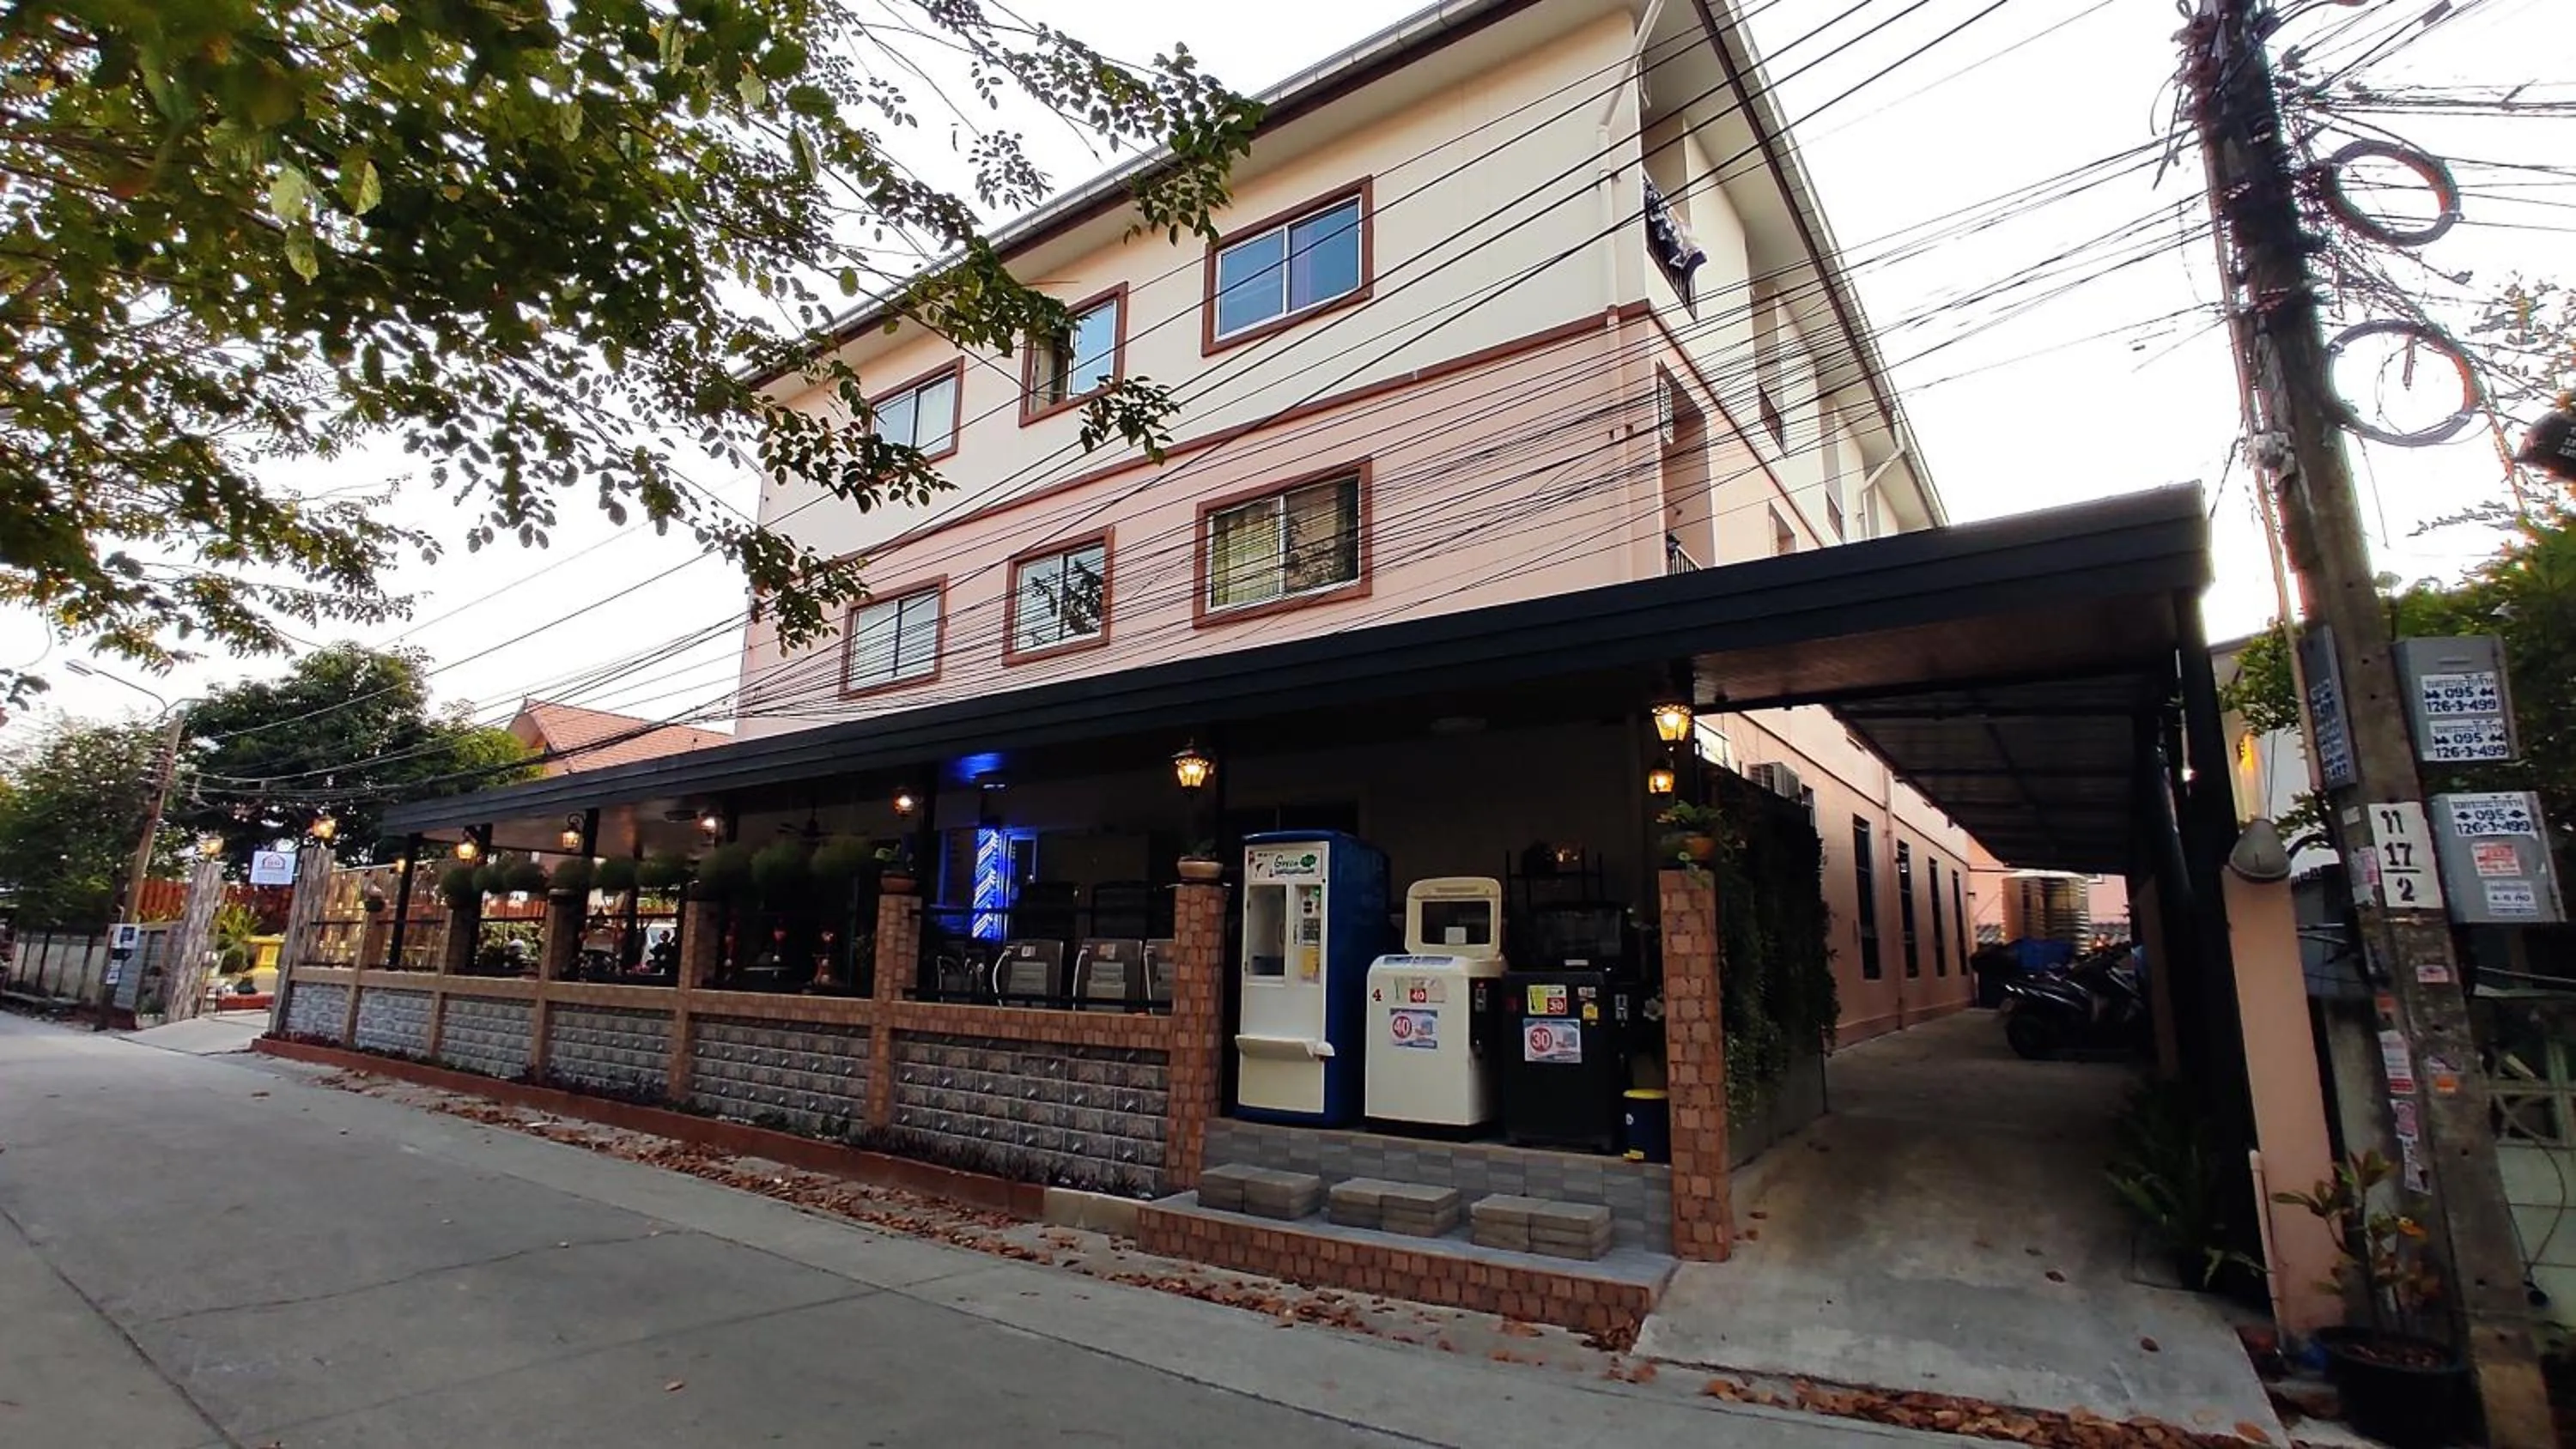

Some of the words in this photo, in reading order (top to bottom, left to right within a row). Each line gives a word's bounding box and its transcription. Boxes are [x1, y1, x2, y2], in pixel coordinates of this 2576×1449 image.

[2445, 687, 2474, 698] 095
[2427, 700, 2497, 712] 126-3-499
[2453, 733, 2483, 743] 095
[2434, 744, 2506, 758] 126-3-499
[2474, 809, 2506, 821] 095
[2457, 821, 2531, 835] 126-3-499
[2384, 842, 2412, 866] 17
[2397, 876, 2415, 902] 2
[1372, 989, 1382, 1002] 4
[1411, 990, 1425, 999] 40
[1548, 998, 1564, 1011] 30
[1394, 1019, 1409, 1034] 40
[1532, 1032, 1551, 1049] 30
